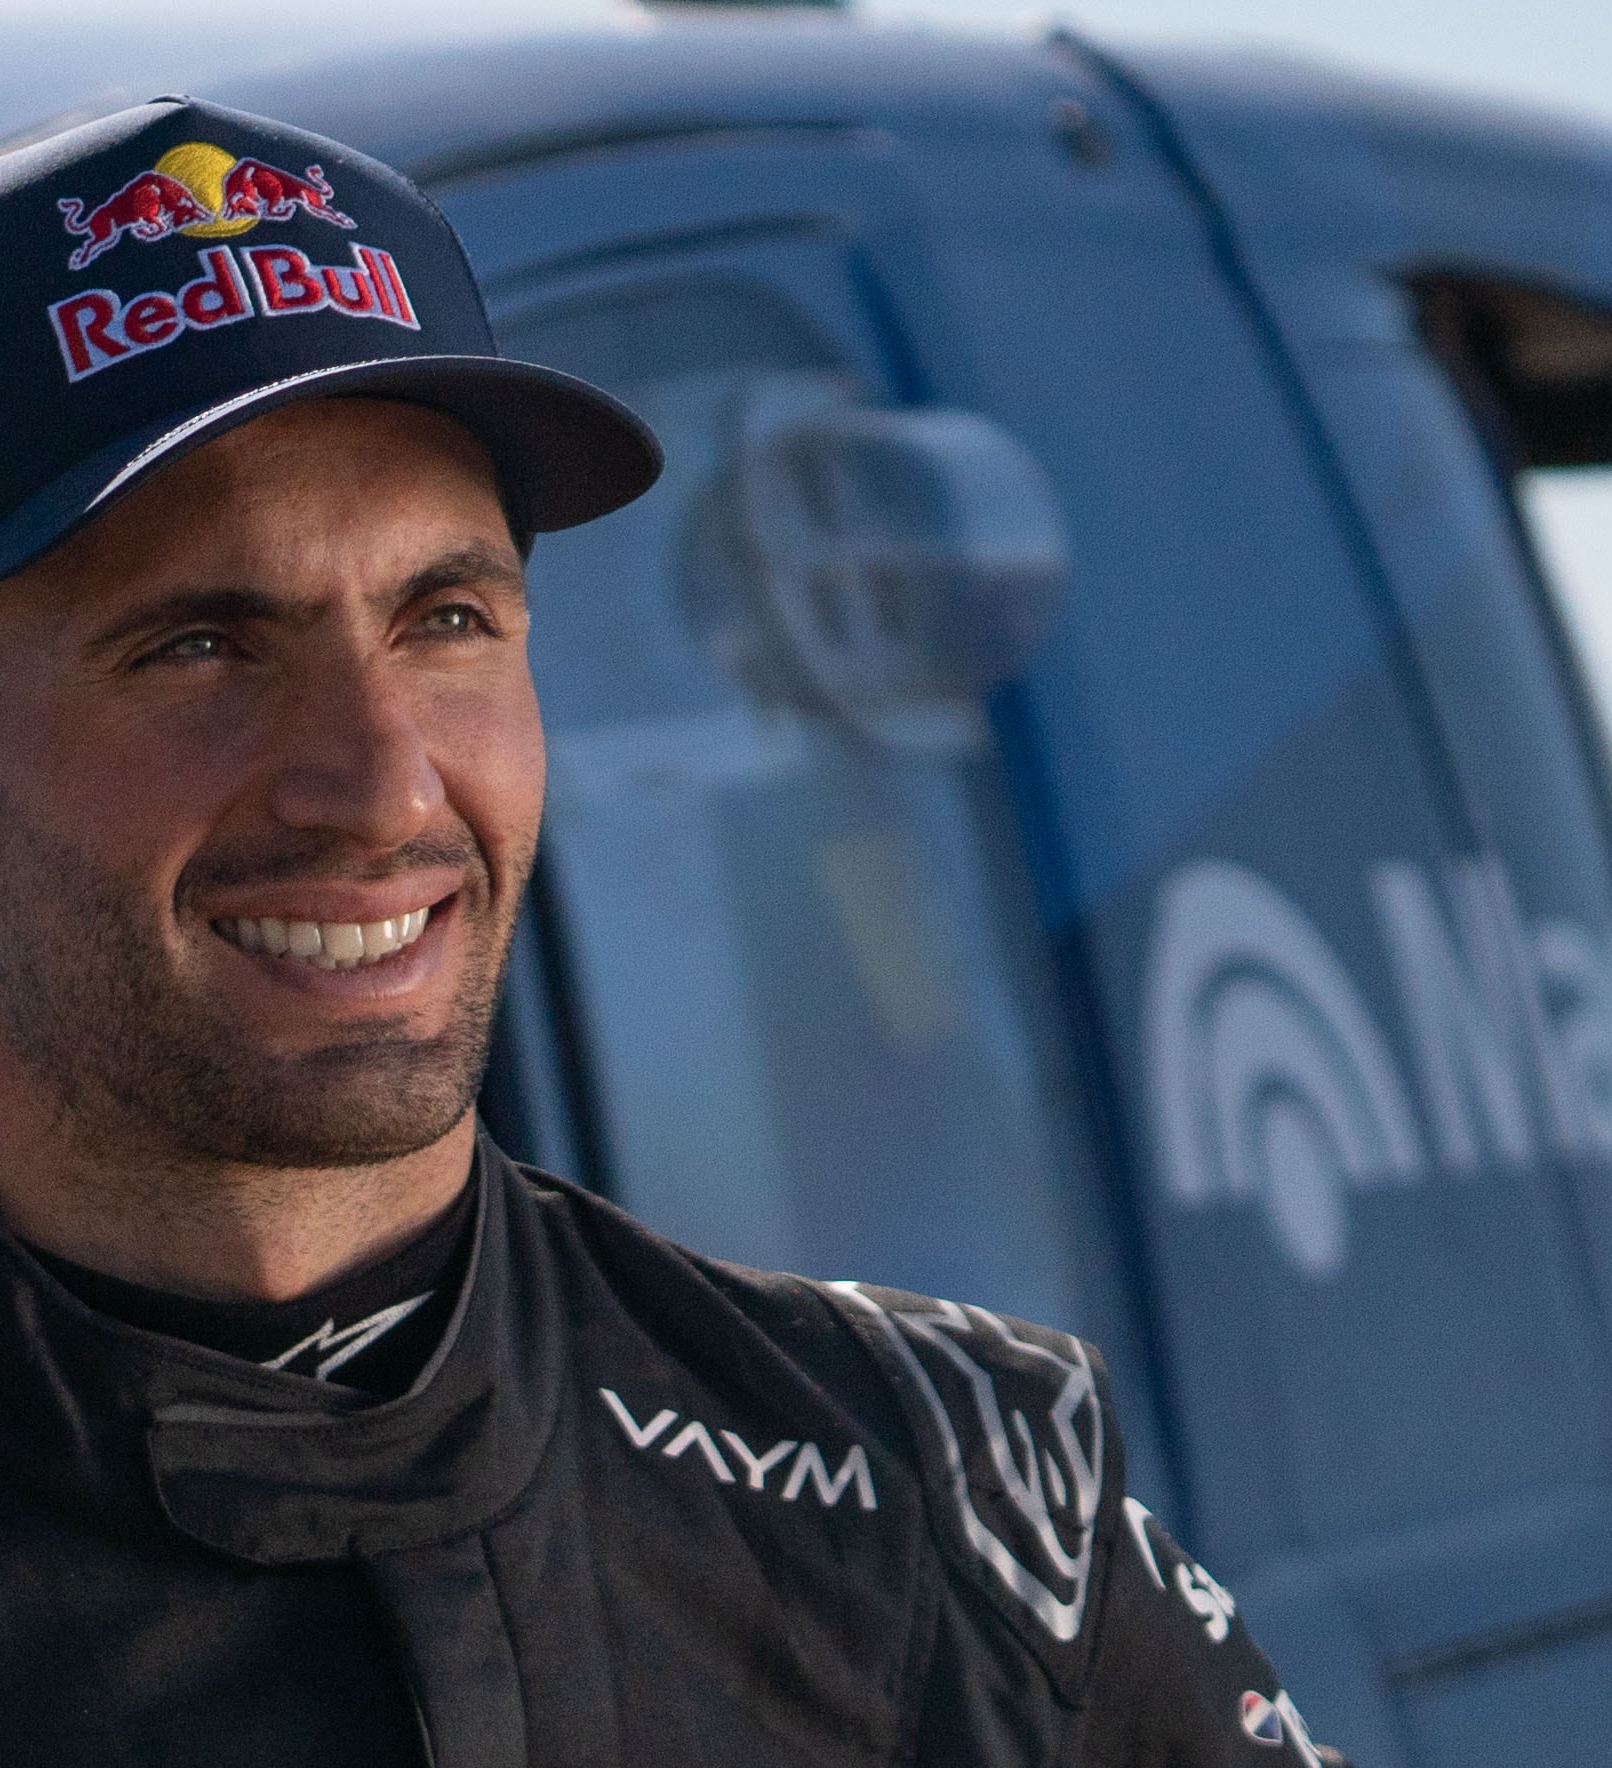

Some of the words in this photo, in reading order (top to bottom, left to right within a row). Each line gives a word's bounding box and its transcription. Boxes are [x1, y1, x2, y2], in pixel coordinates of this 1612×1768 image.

[48, 244, 255, 384] Red
[239, 242, 422, 332] Bull
[598, 1387, 877, 1511] VAYM
